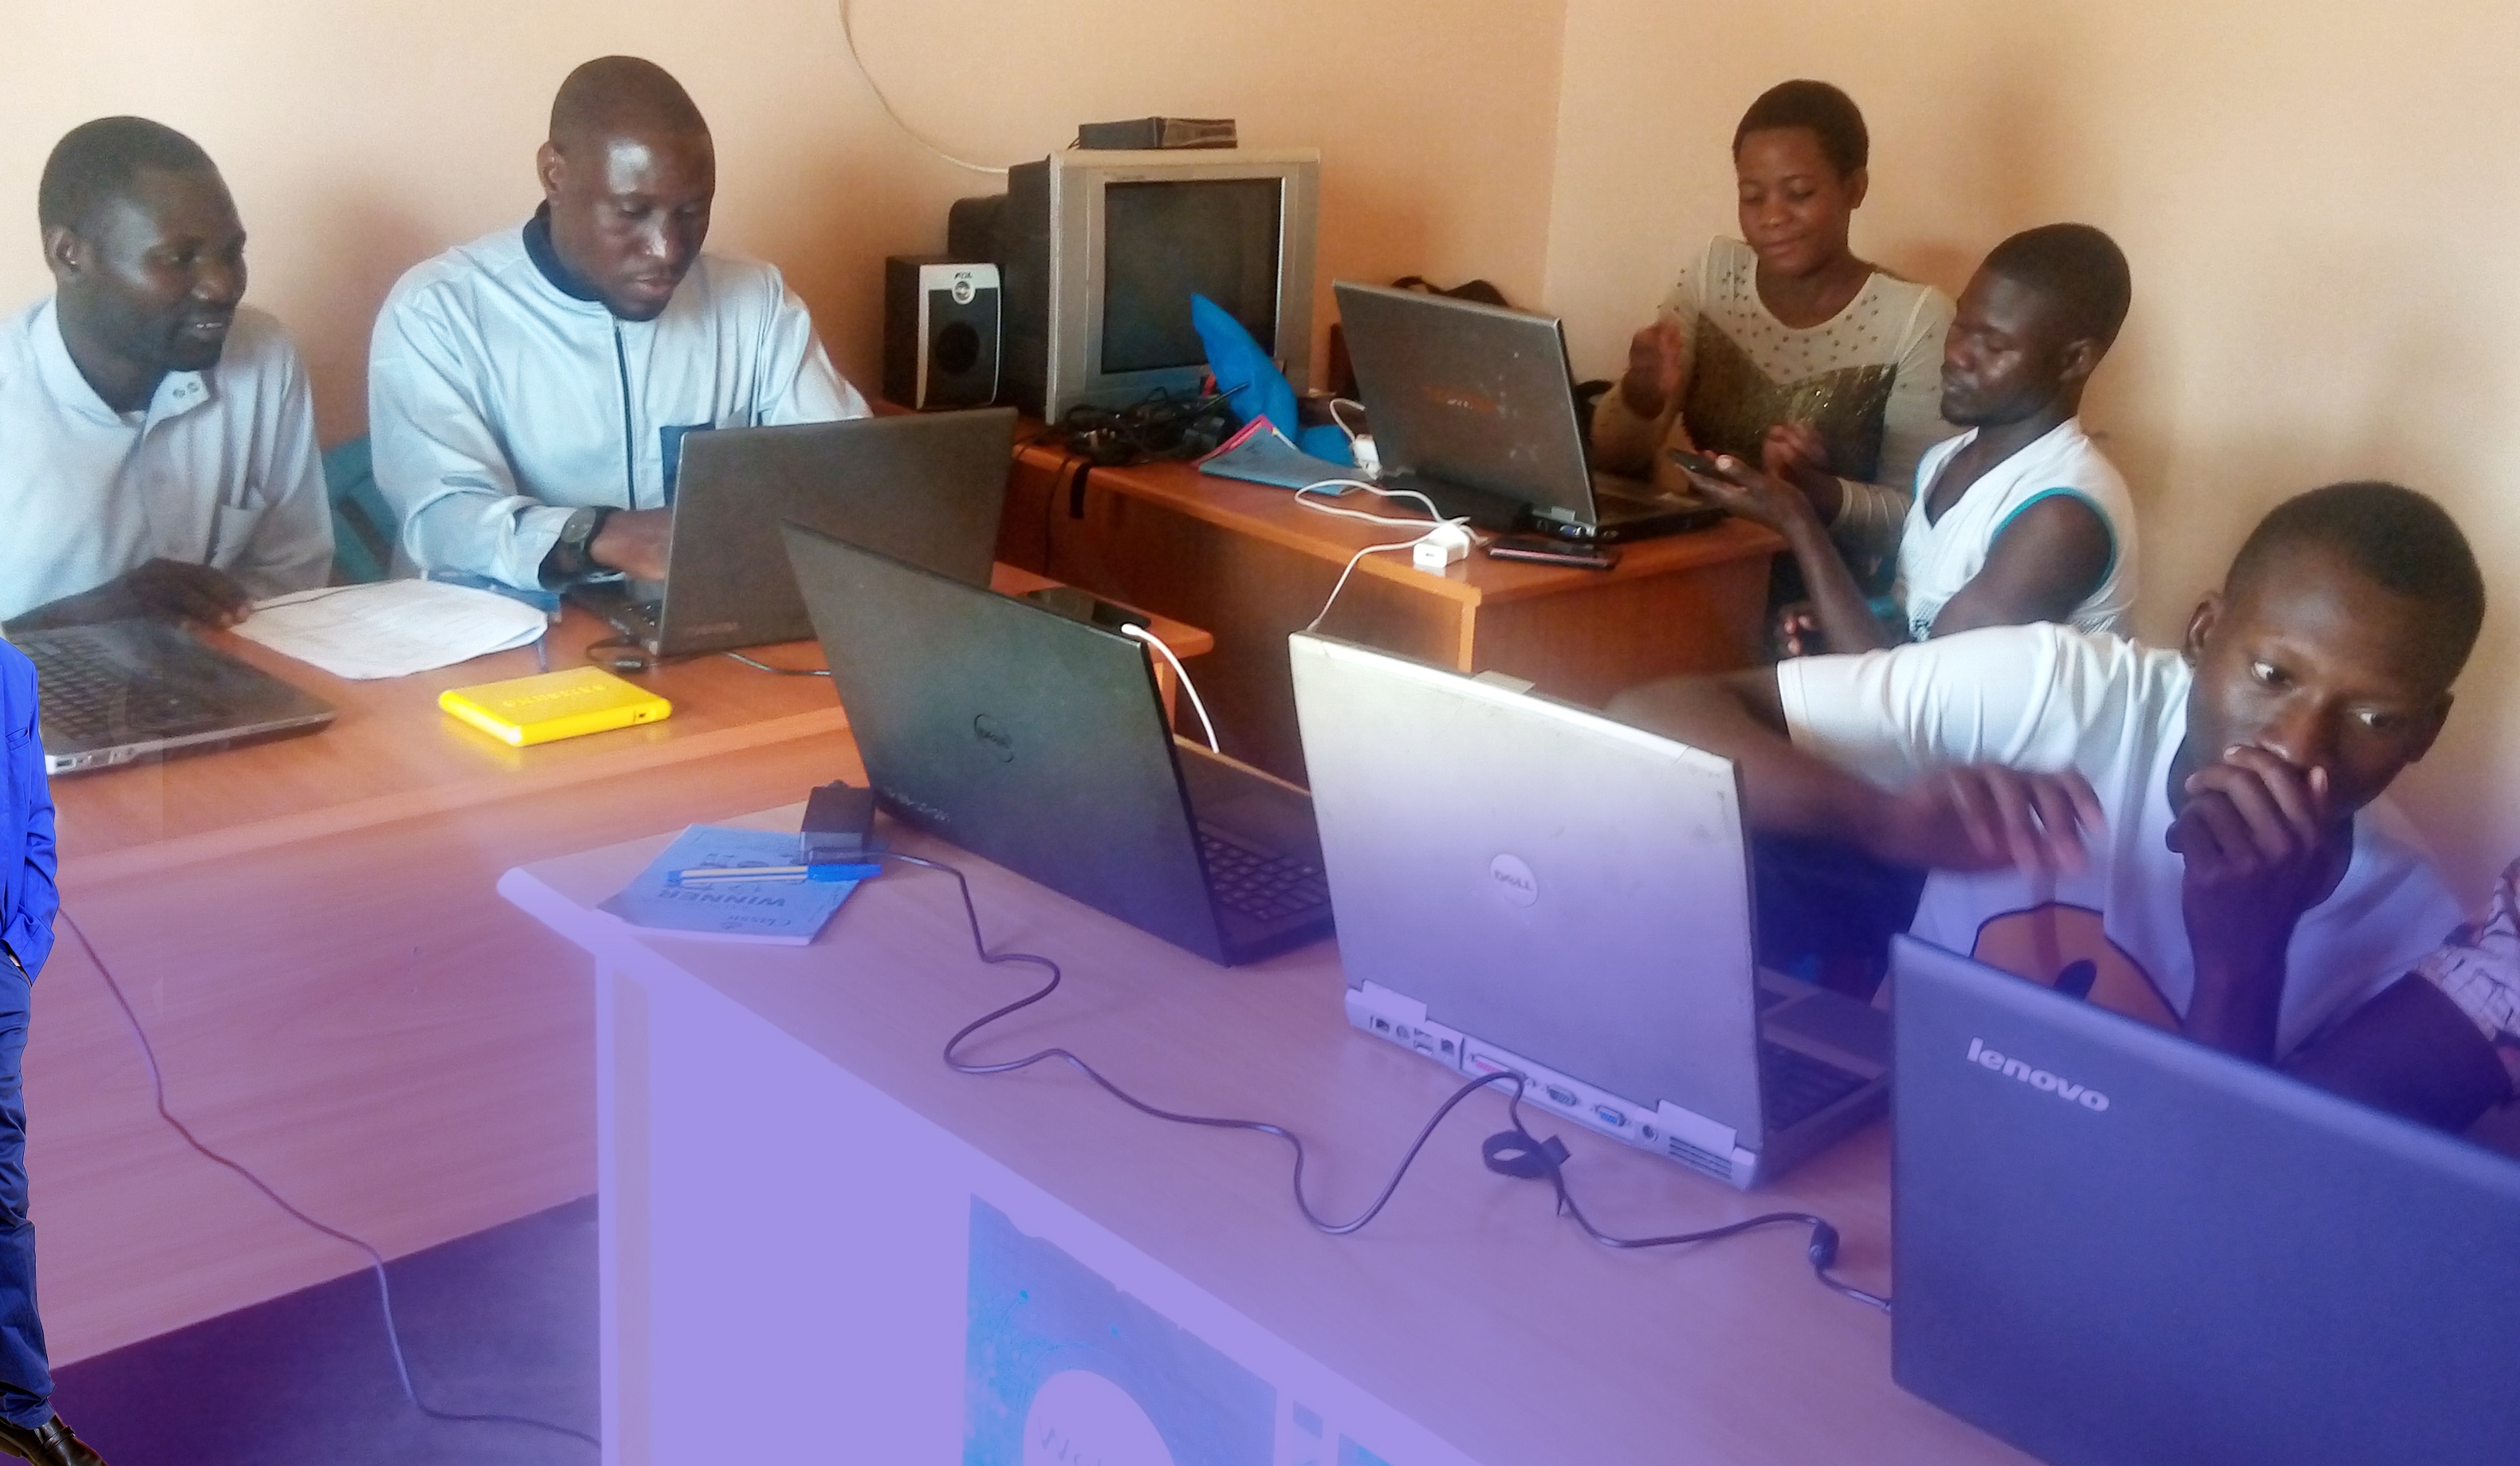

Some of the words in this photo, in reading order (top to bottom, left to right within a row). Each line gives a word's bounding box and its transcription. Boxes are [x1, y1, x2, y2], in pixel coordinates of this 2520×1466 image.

[1494, 870, 1534, 892] DELL
[658, 889, 786, 907] WINNER
[1967, 1036, 2110, 1111] lenovo
